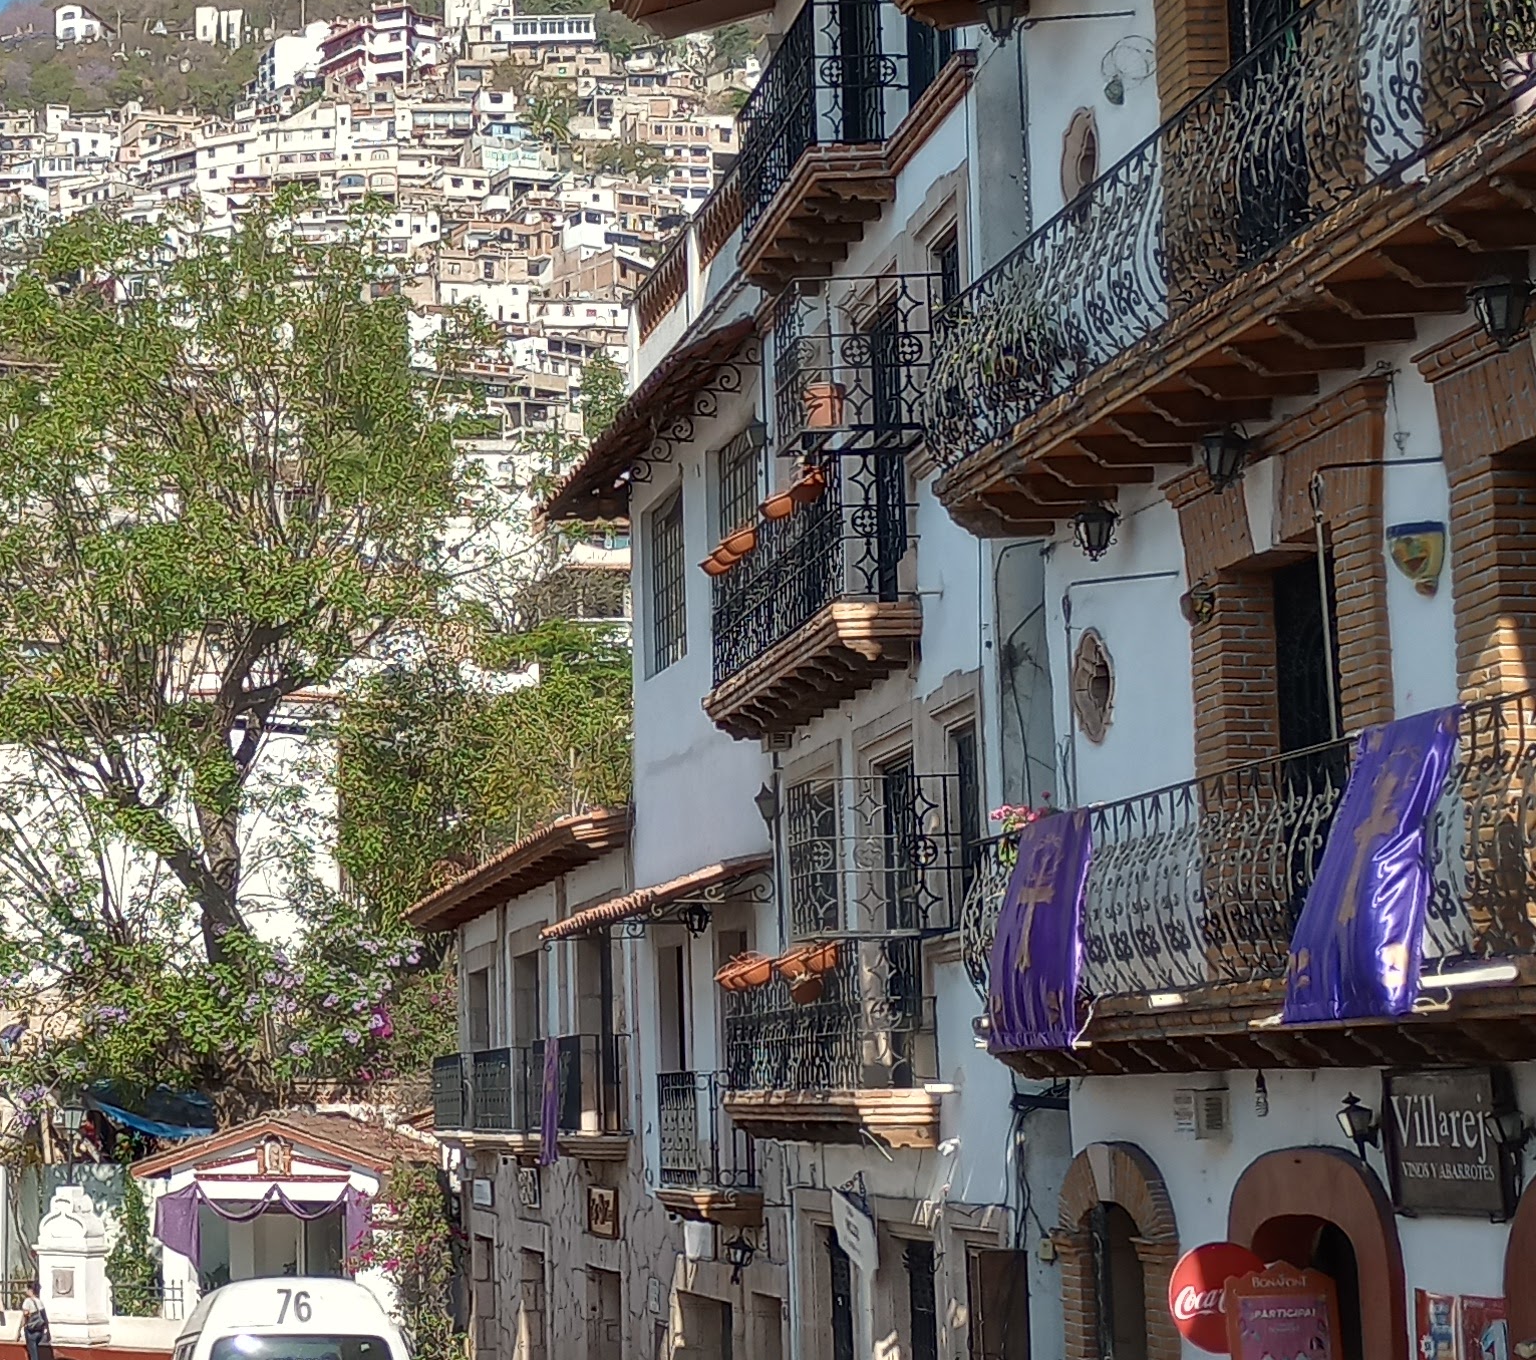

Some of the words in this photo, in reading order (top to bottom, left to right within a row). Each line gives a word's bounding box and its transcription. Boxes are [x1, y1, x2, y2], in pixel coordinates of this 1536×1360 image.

[1402, 1161, 1429, 1178] VINOS
[1430, 1162, 1439, 1178] Y
[1439, 1162, 1495, 1181] ABARROTES
[276, 1288, 312, 1324] 76
